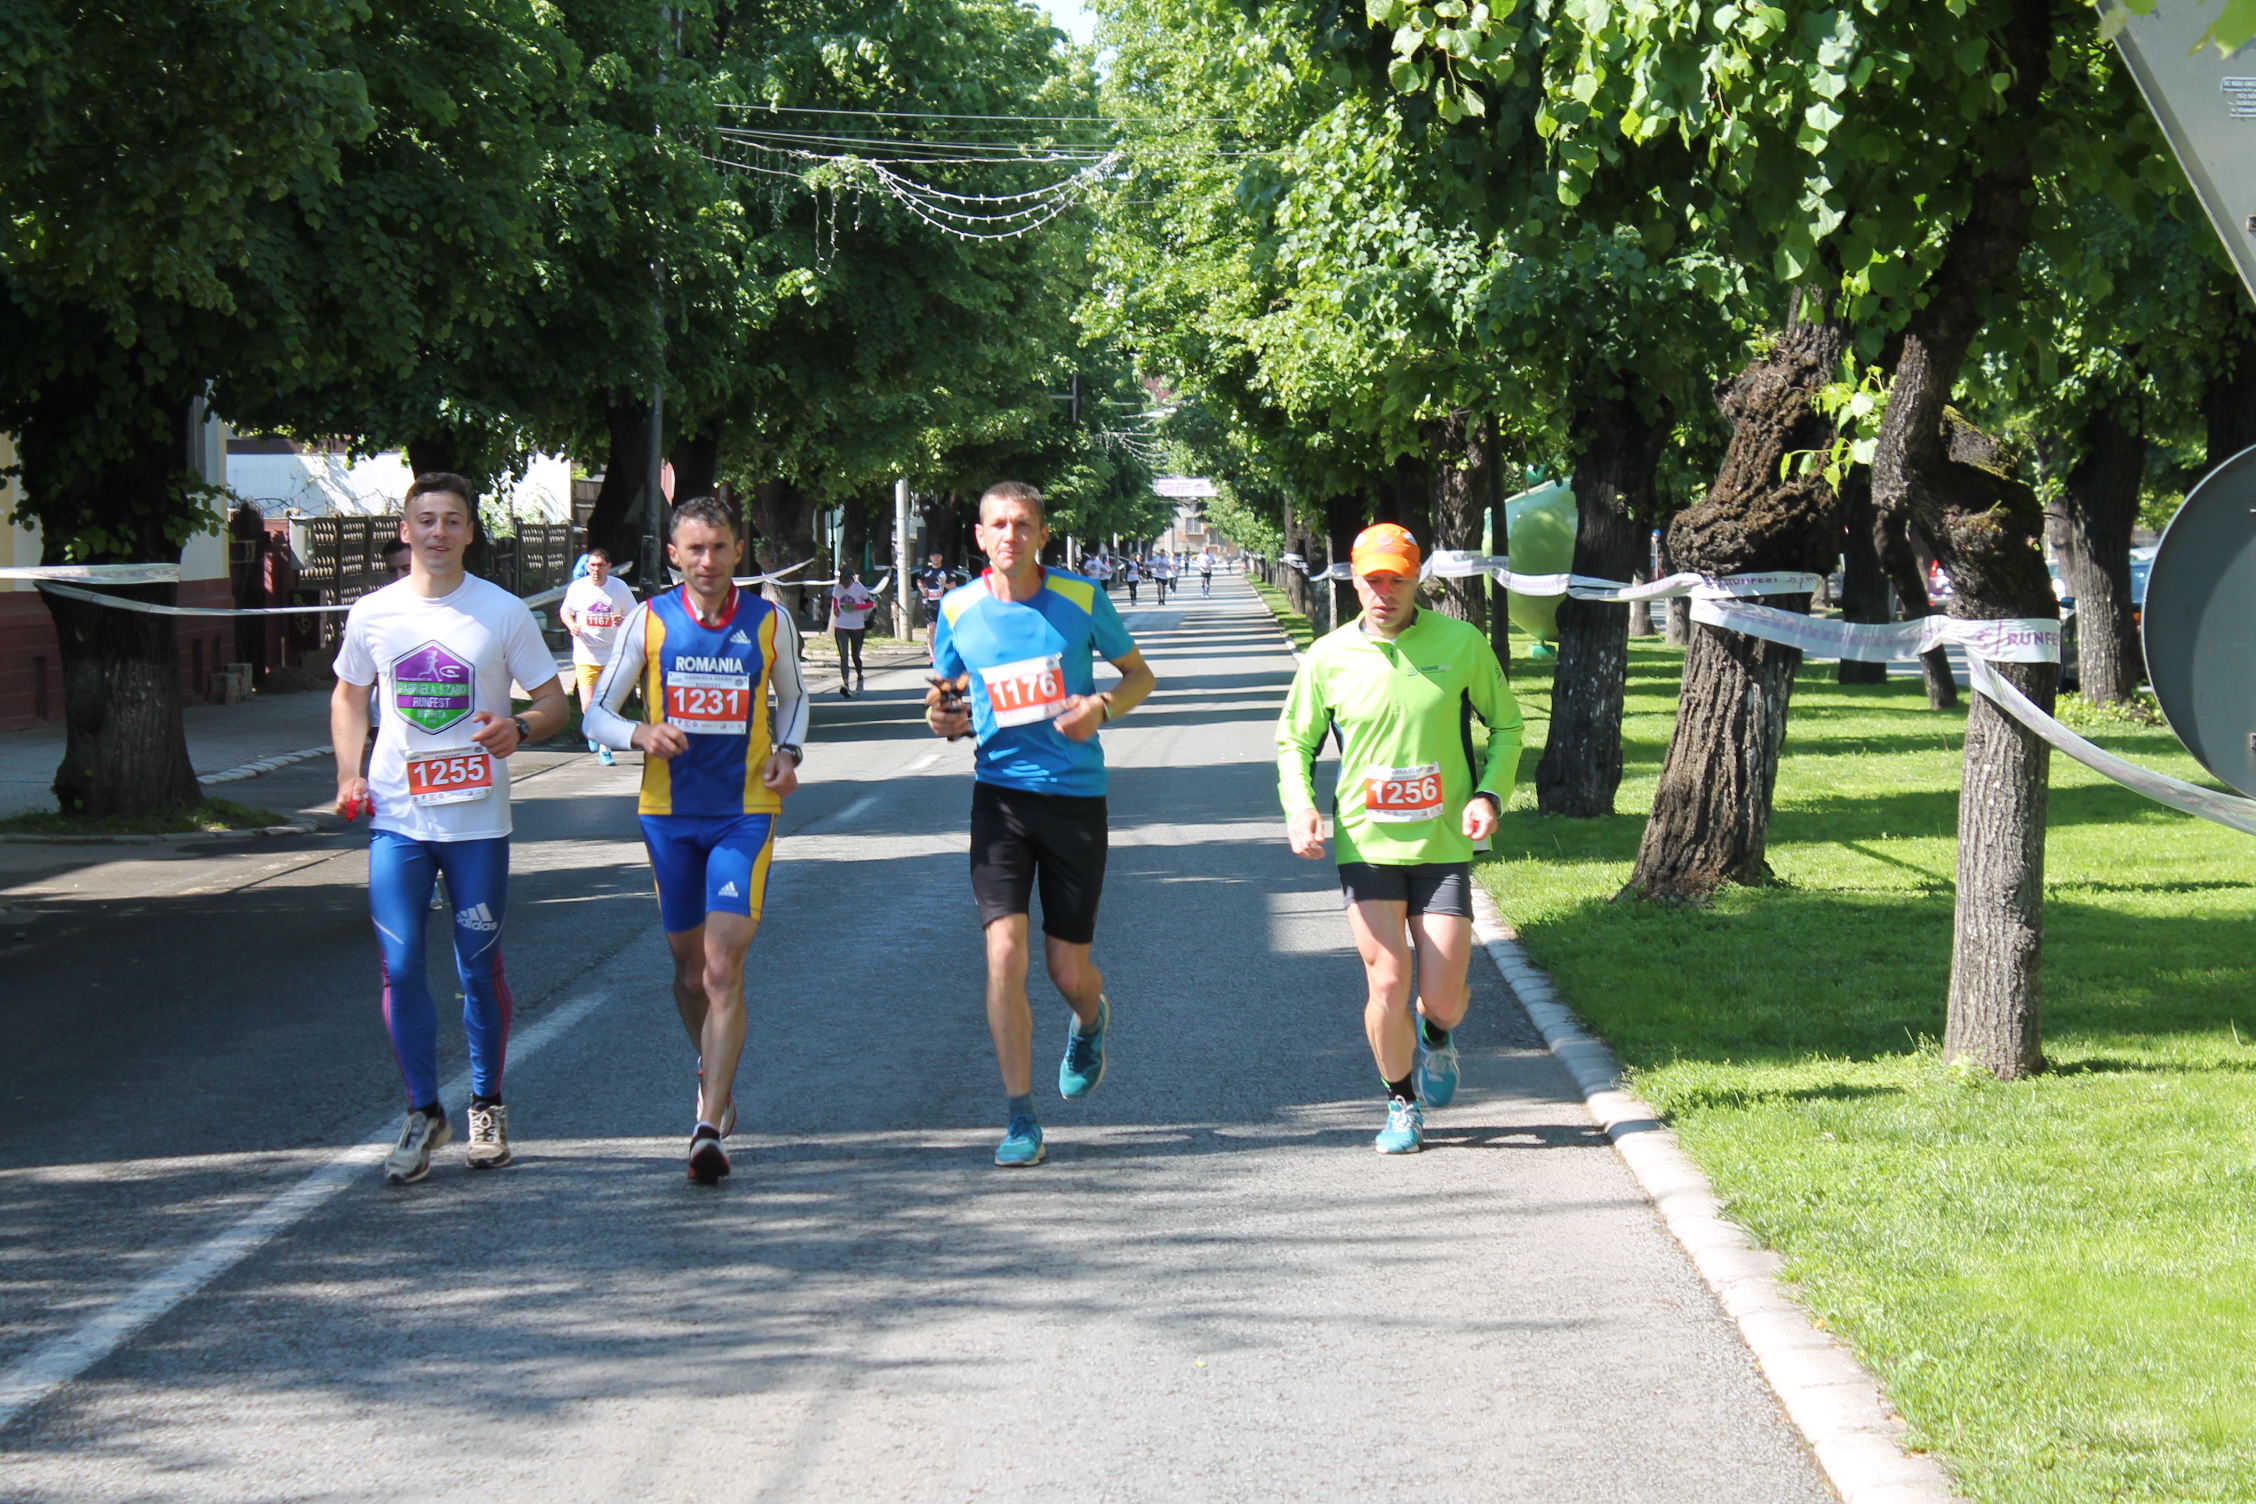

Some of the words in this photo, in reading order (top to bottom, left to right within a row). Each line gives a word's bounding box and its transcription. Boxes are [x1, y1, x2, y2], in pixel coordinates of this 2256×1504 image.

[588, 616, 610, 626] 1167
[675, 656, 744, 673] ROMANIA
[397, 683, 437, 695] GABRIELA
[439, 684, 467, 696] SZABO
[992, 671, 1058, 708] 1176
[412, 696, 451, 708] RUNFEST
[673, 688, 738, 715] 1231
[413, 756, 485, 787] 1255
[1370, 777, 1438, 804] 1256
[456, 913, 498, 931] adidas
